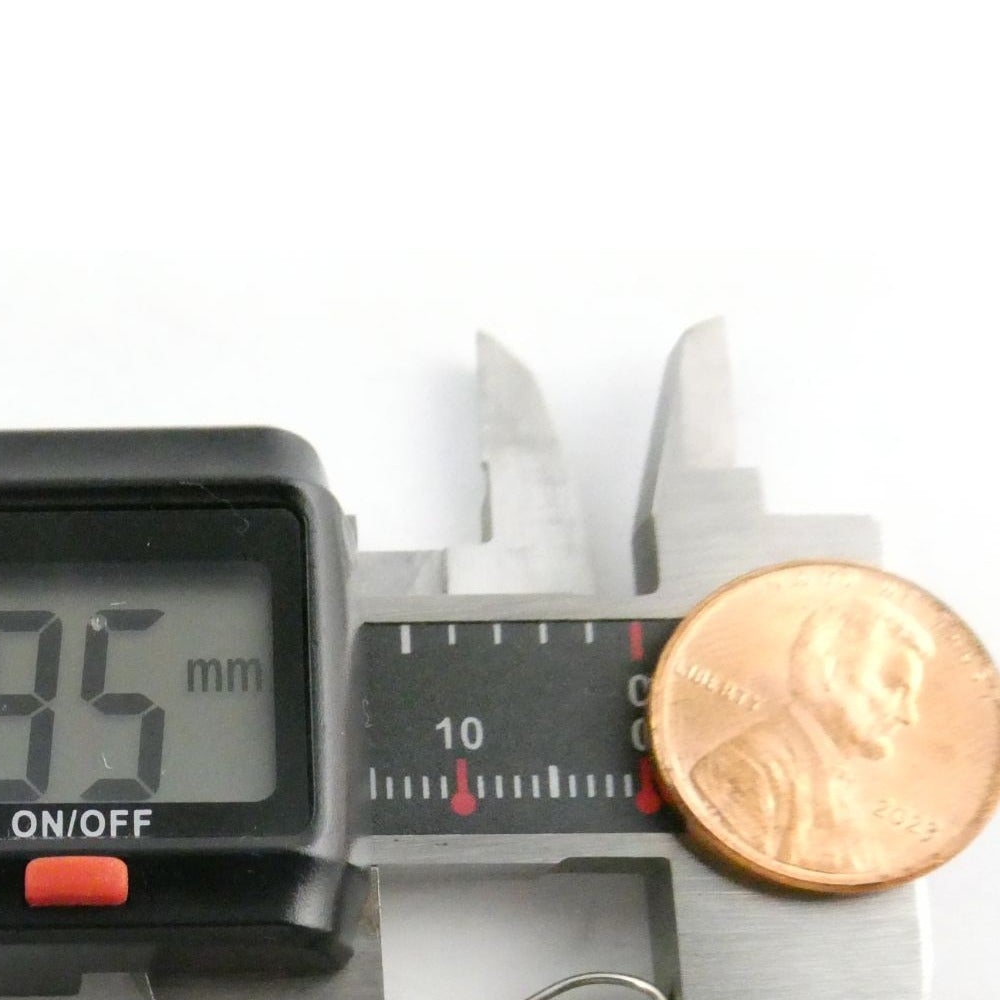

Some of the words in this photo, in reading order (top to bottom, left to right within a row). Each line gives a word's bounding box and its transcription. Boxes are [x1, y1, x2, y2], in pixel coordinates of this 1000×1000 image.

[187, 657, 263, 693] mm
[435, 716, 484, 750] 10
[11, 809, 153, 838] ON/OFF
